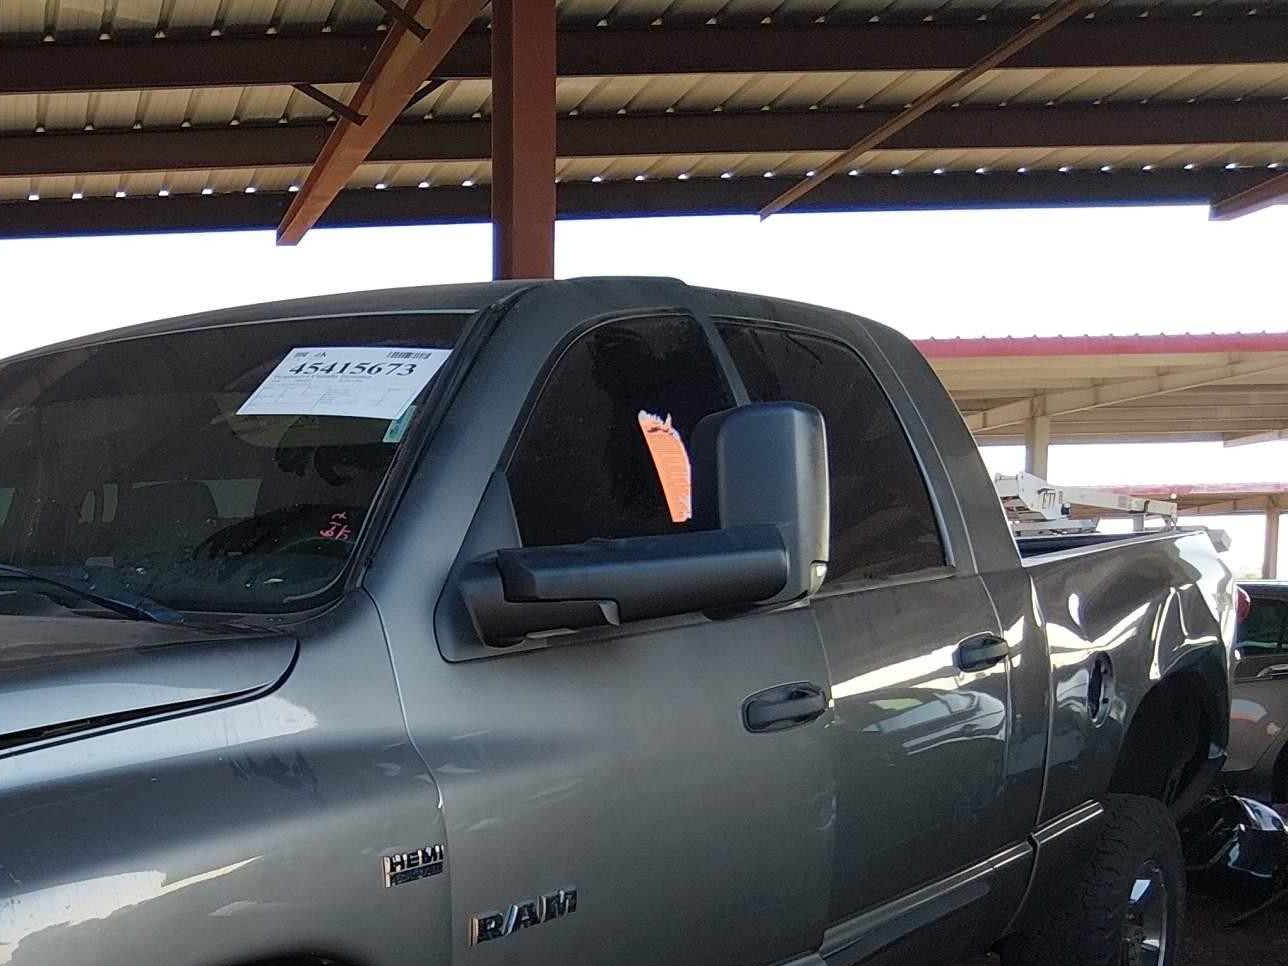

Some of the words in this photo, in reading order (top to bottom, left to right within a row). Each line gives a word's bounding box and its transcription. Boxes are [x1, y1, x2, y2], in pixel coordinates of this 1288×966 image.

[289, 361, 418, 376] 45415673
[383, 844, 445, 884] HEMI
[469, 884, 578, 946] RAM
